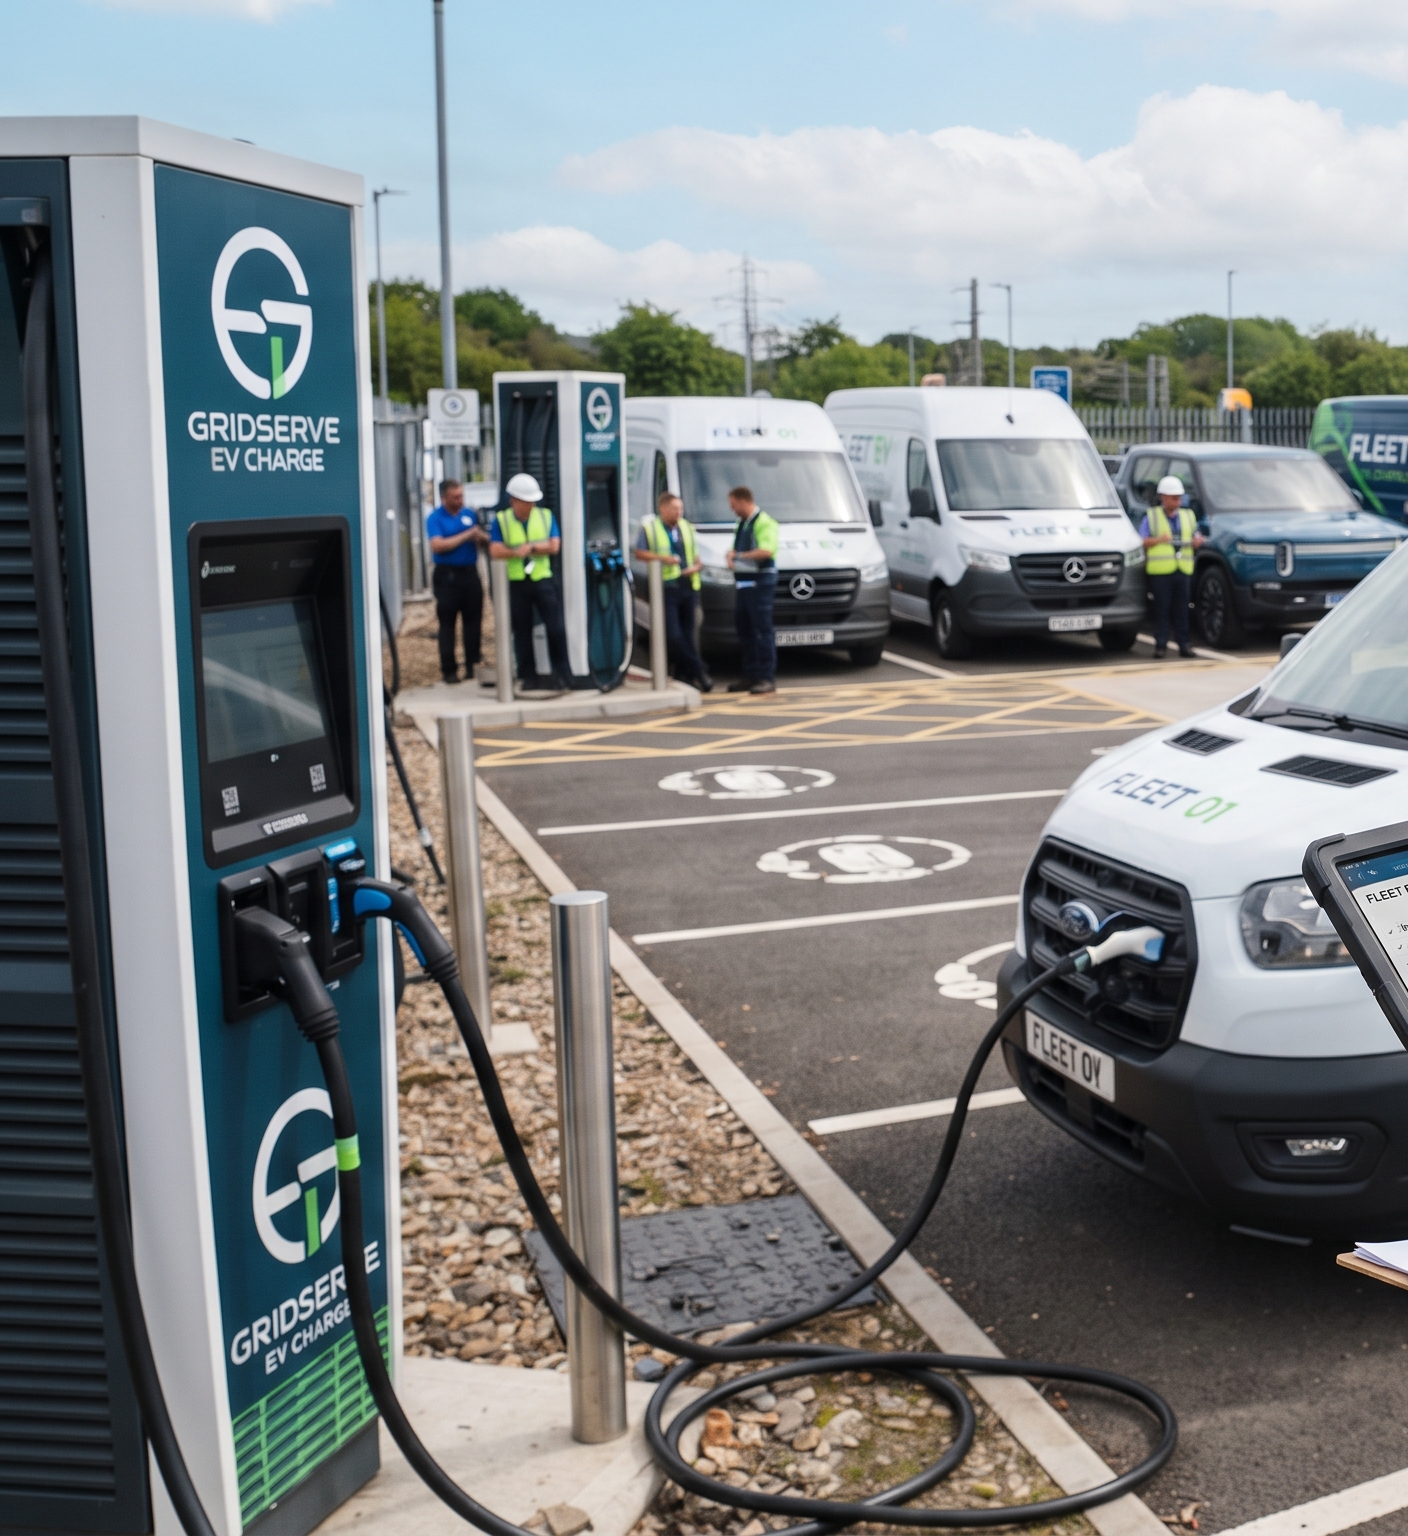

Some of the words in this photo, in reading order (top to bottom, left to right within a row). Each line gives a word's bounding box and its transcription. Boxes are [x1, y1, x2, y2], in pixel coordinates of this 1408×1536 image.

[187, 411, 341, 444] GRIDSERVE
[211, 447, 240, 472] EV
[244, 447, 325, 472] CHARGE
[1098, 772, 1201, 810] FLEET
[1365, 886, 1404, 904] FLEET
[1033, 1021, 1077, 1073] FLEET
[230, 1240, 381, 1366] GRIDSERE
[265, 1341, 288, 1375] EV
[291, 1298, 352, 1355] CHARGE
